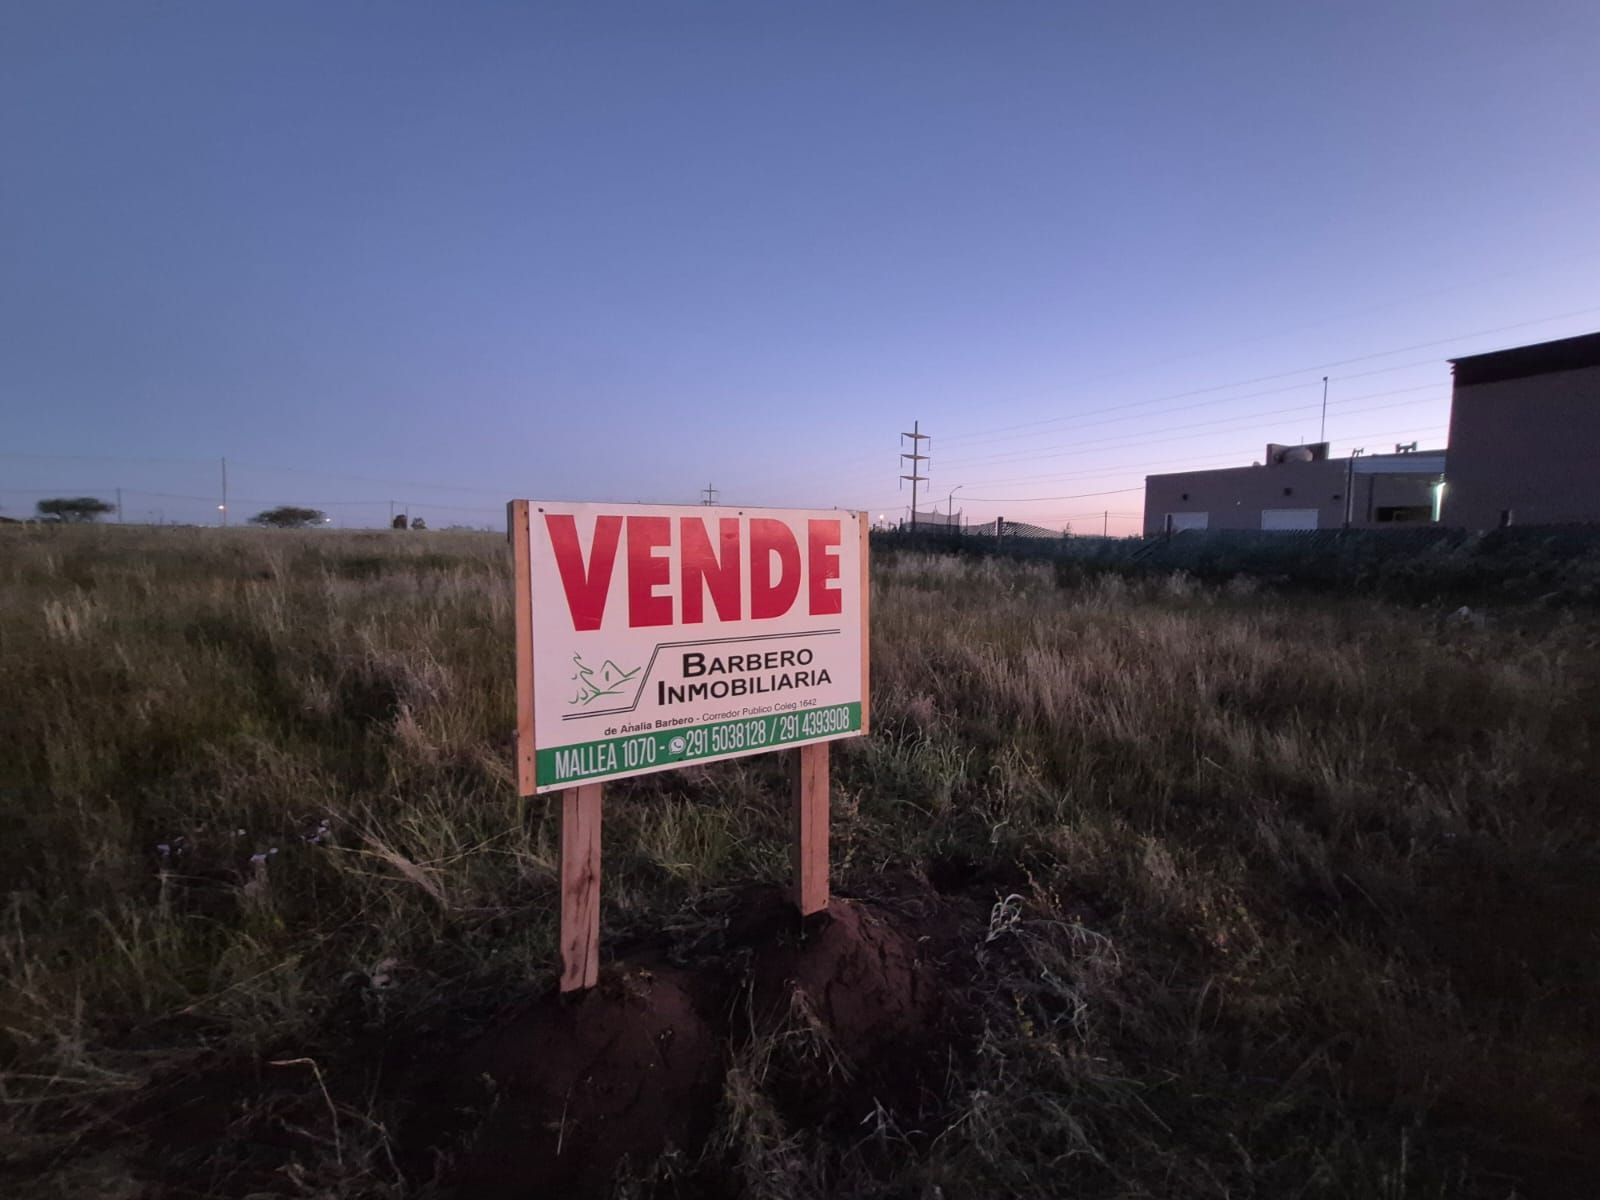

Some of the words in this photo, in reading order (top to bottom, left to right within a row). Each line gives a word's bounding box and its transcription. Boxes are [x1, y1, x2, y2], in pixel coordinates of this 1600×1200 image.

[544, 514, 842, 632] VENDE
[682, 648, 813, 678] BARBERO
[658, 669, 832, 706] INMOBILIARIA
[604, 727, 617, 736] de
[655, 716, 694, 729] Barbero
[702, 709, 740, 722] Corredor
[799, 698, 817, 707] 1642
[555, 742, 617, 780] MALLEA
[622, 736, 656, 768] 1070
[686, 729, 709, 757] 291
[712, 719, 767, 752] 5038128
[780, 714, 800, 741] 291
[802, 706, 850, 736] 4393908
